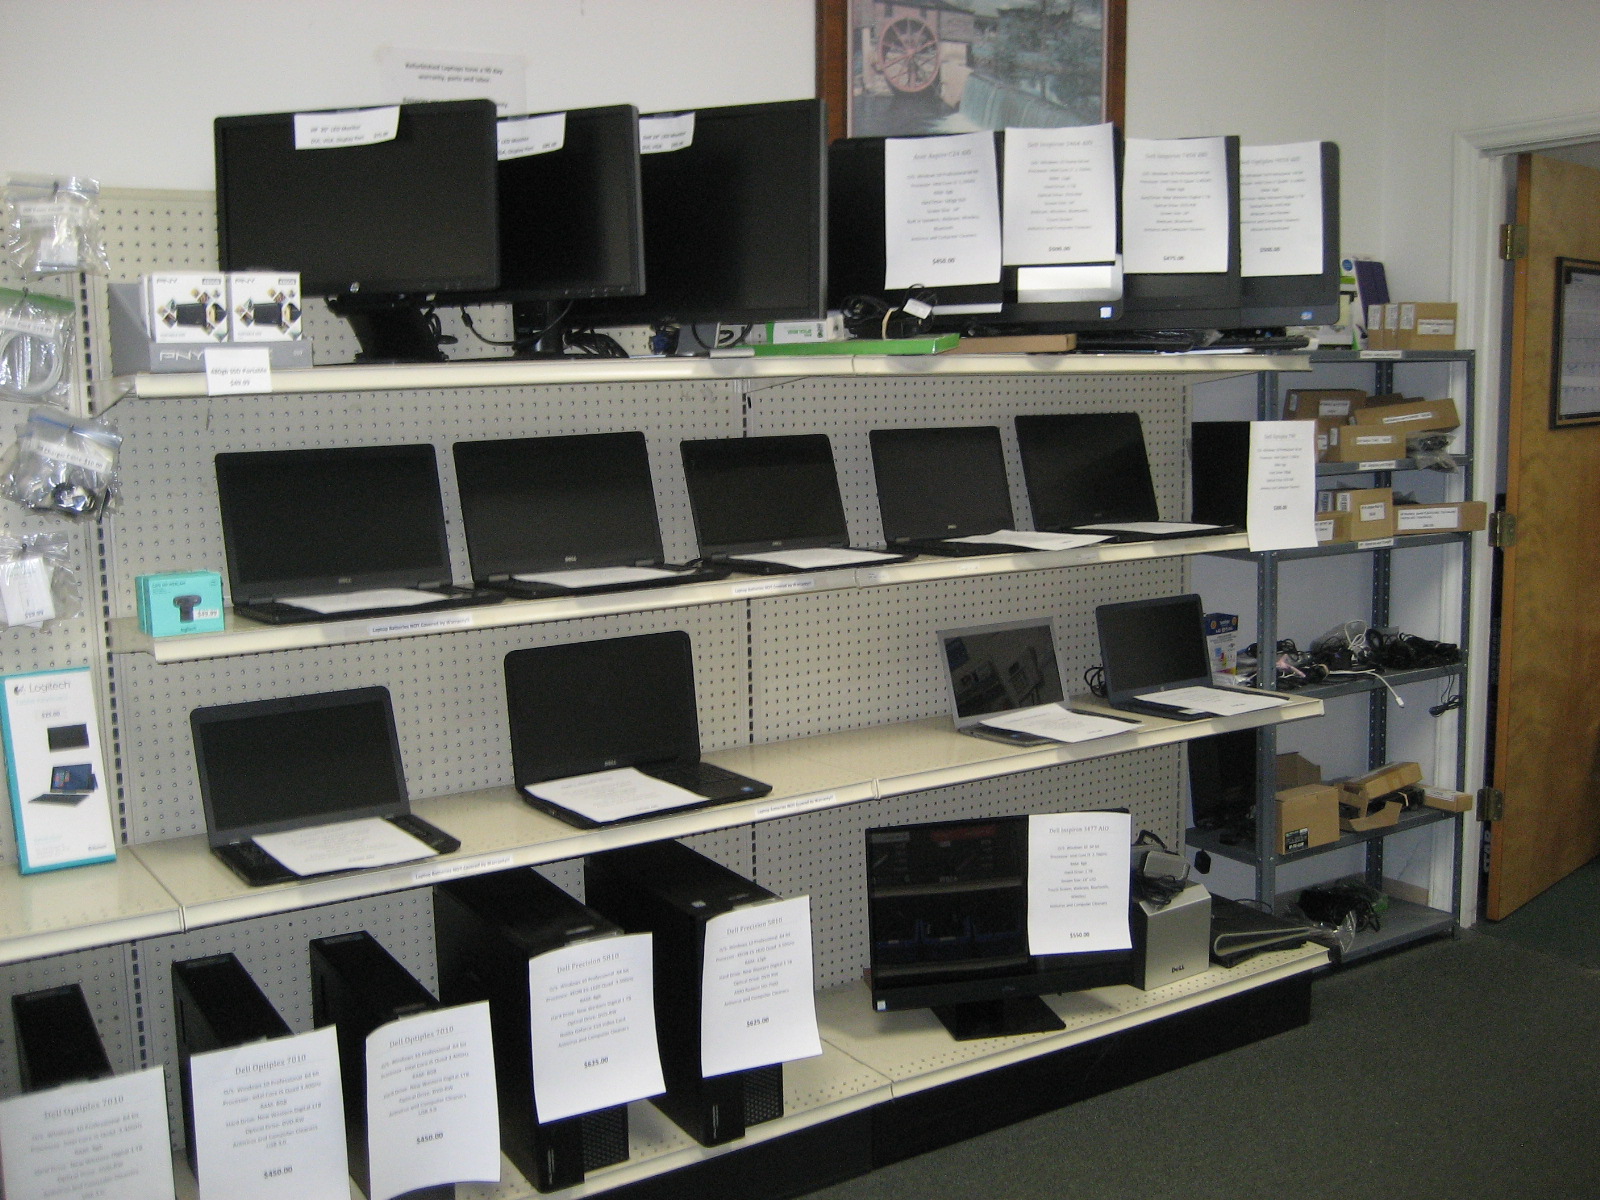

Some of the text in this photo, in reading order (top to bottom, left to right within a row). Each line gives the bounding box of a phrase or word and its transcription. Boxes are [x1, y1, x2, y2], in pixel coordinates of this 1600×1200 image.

[159, 352, 204, 362] PNY
[30, 681, 71, 693] Logitech
[726, 926, 738, 935] Dell
[740, 922, 767, 932] Precision
[557, 952, 620, 974] Dell Precision 5810
[1171, 964, 1185, 974] DELL
[389, 1026, 454, 1049] Dell Optiplex 7010
[235, 1054, 306, 1075] Dell Optiplex 7010
[44, 1096, 124, 1119] Dell Optiplex 7010
[416, 1132, 444, 1145] $450.00
[264, 1165, 293, 1179] $450.00
